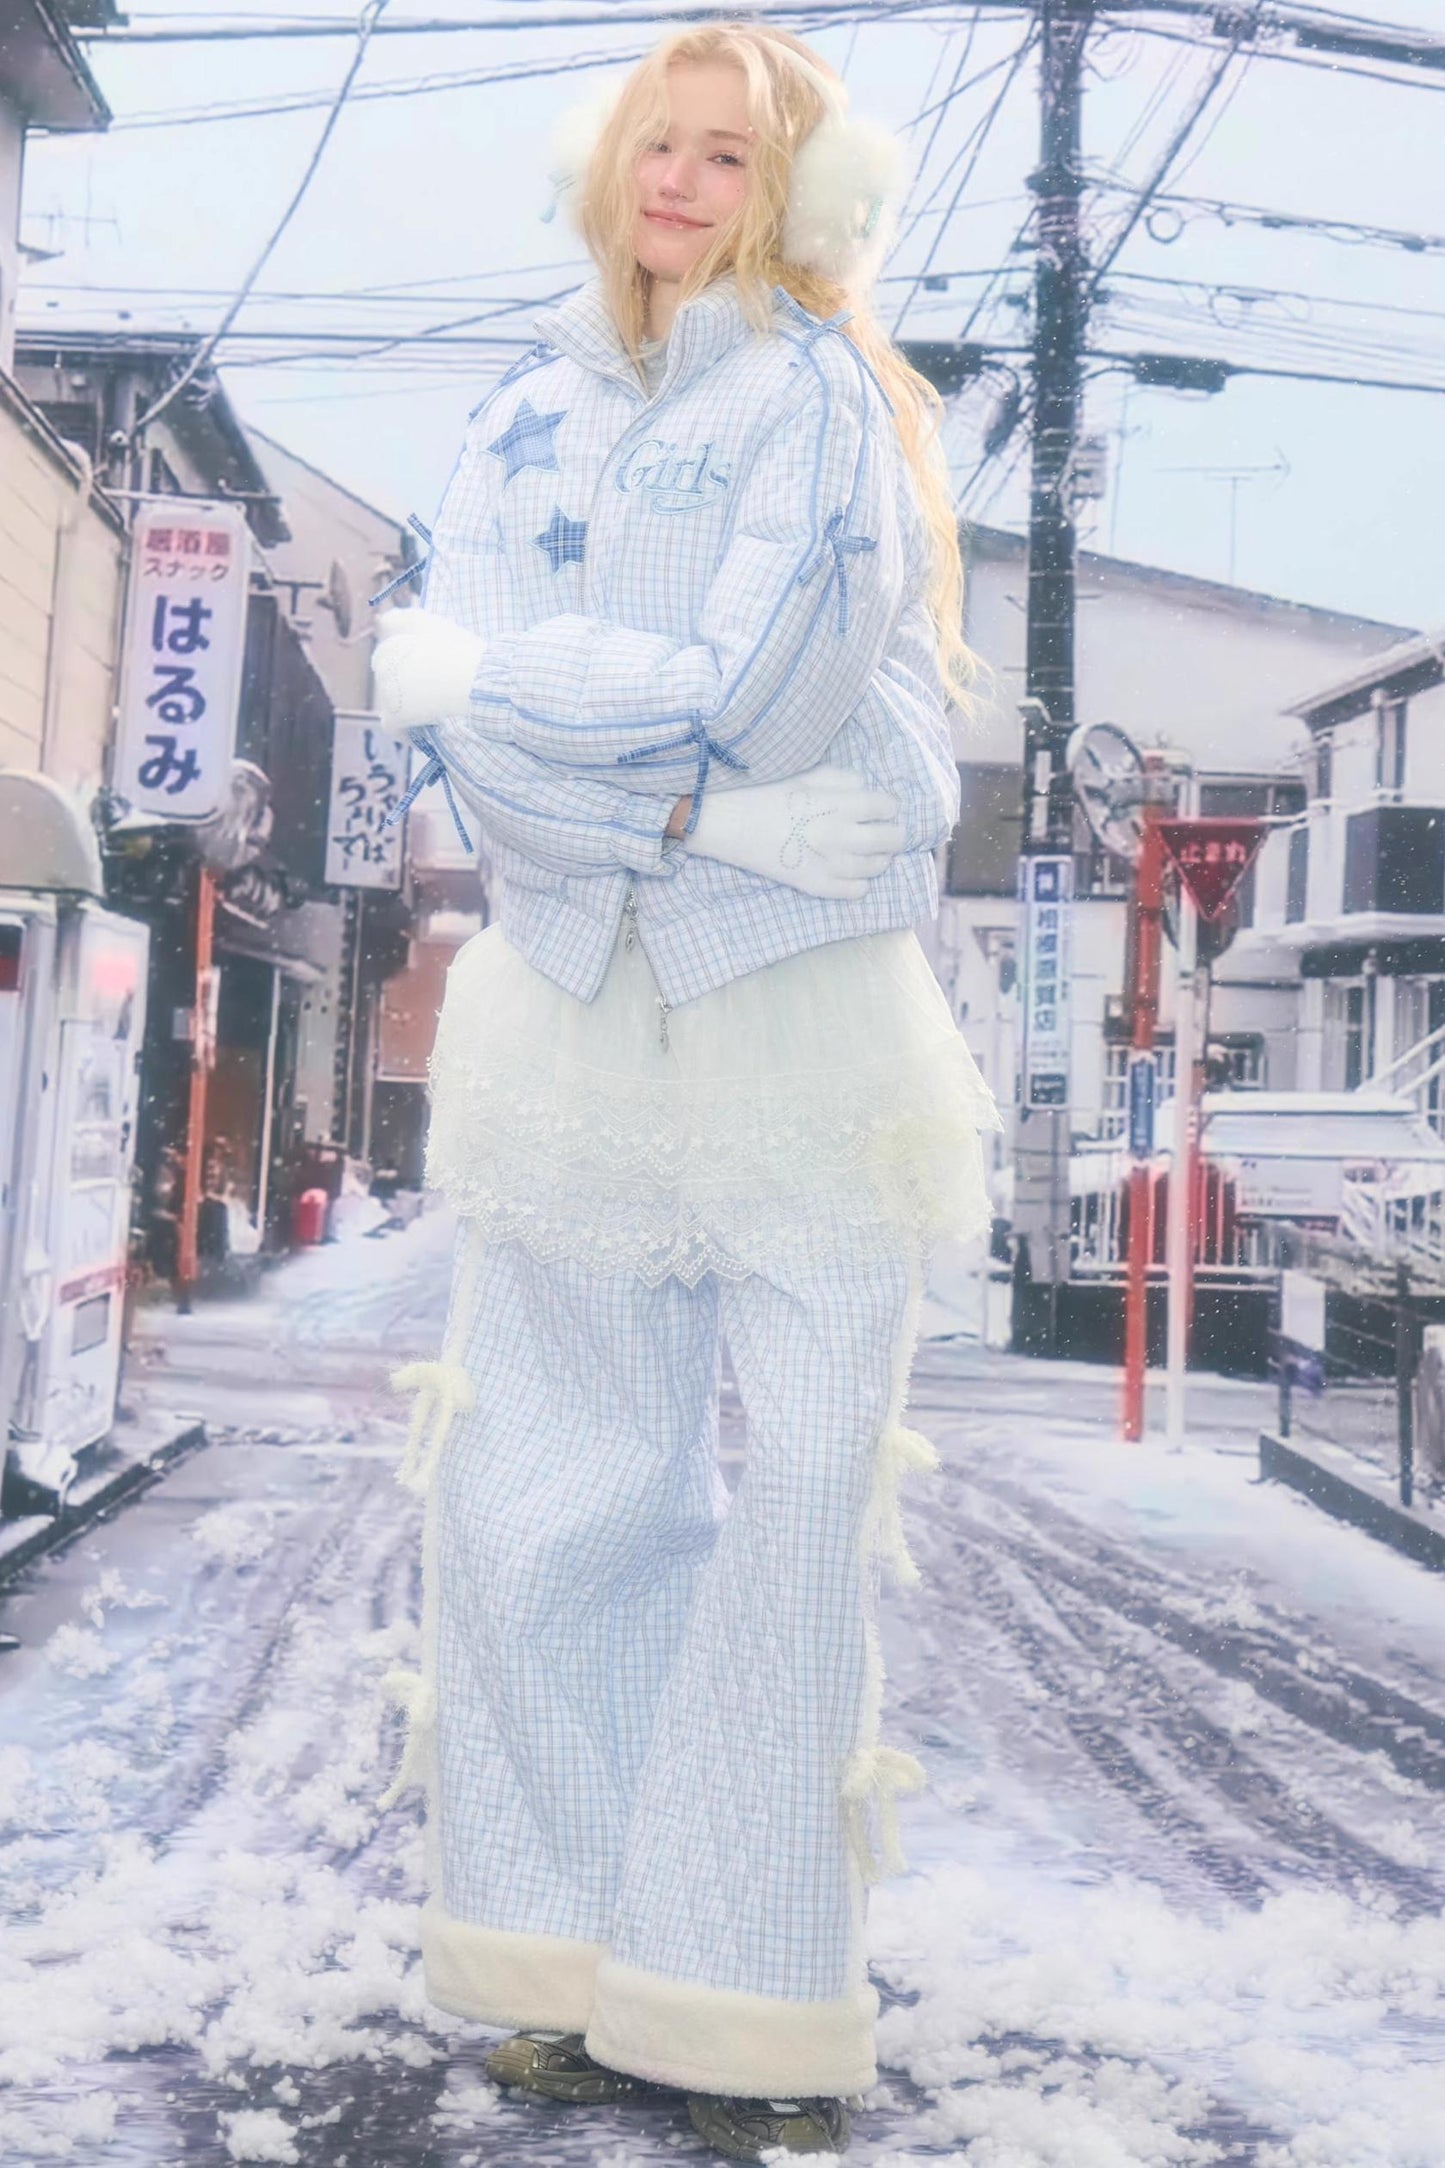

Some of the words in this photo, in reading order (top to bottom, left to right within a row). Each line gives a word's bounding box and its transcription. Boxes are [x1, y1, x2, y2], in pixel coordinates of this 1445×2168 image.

[614, 439, 731, 495] Girls
[143, 557, 230, 582] スナック
[138, 596, 213, 796] はるみ
